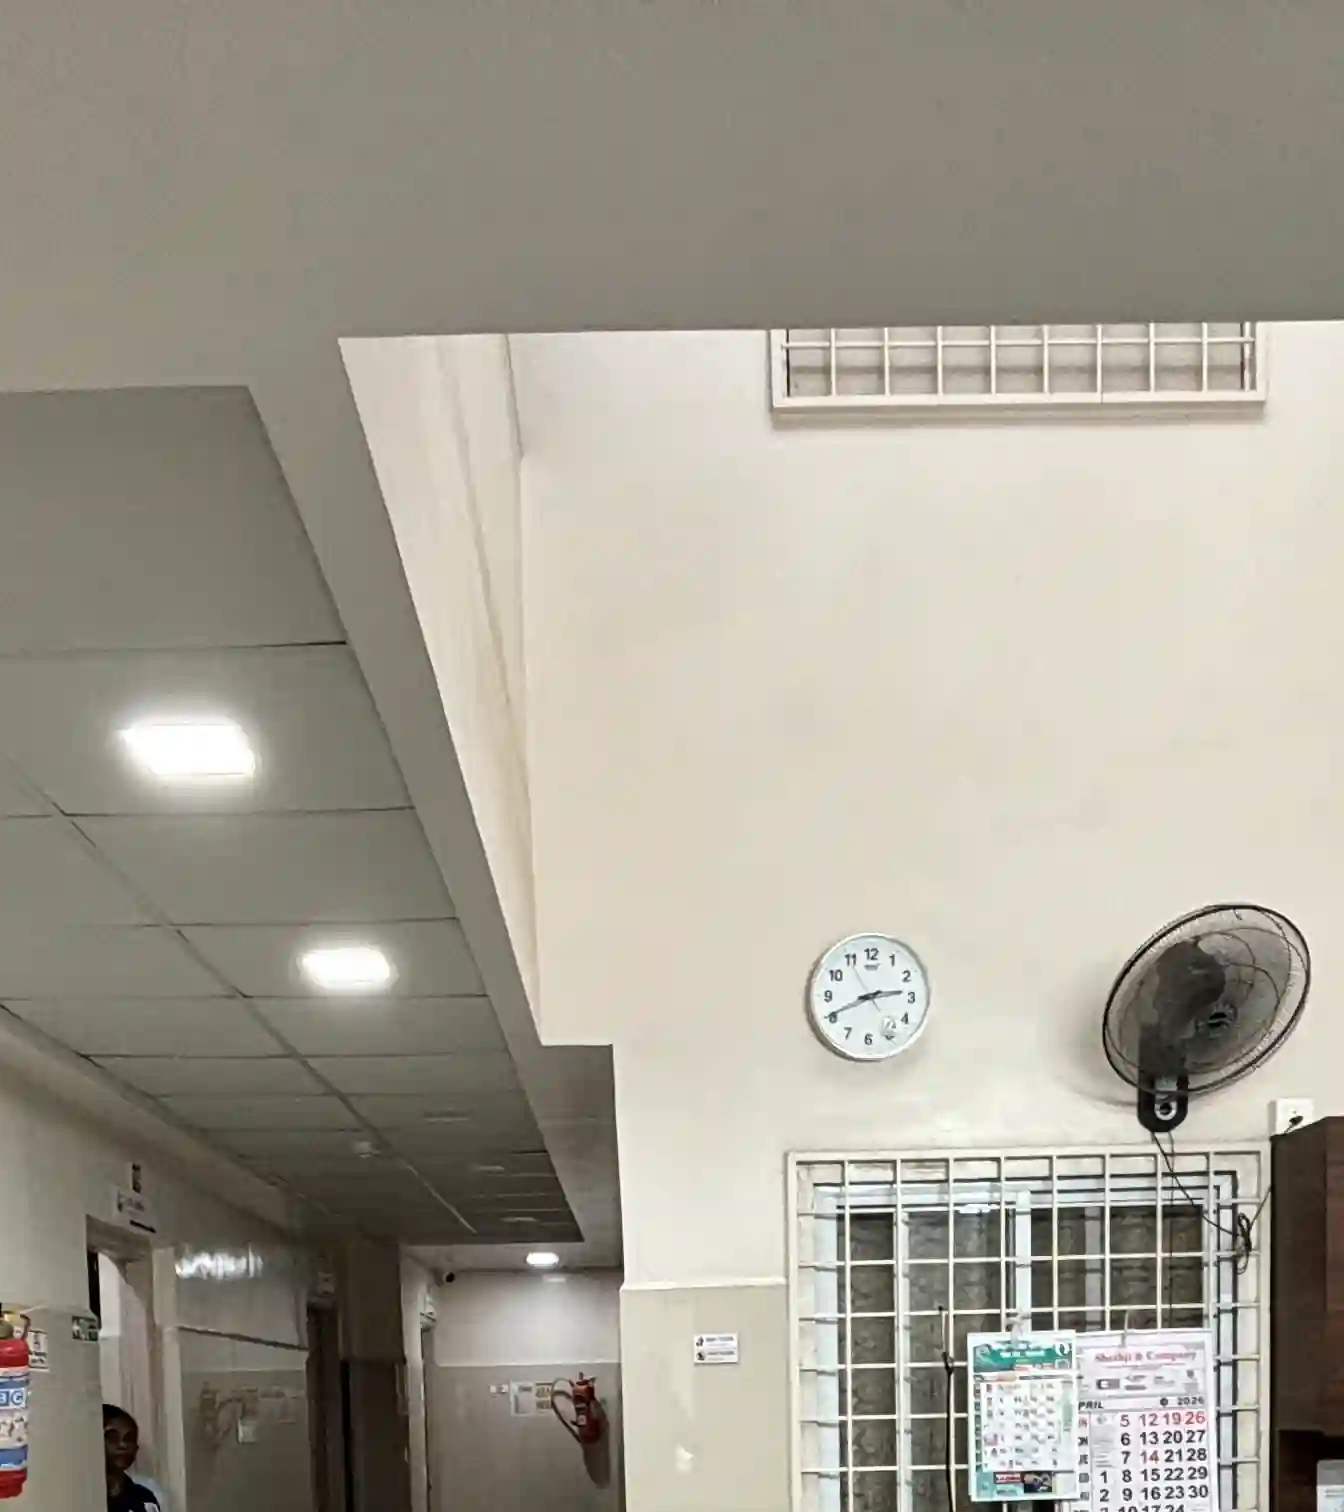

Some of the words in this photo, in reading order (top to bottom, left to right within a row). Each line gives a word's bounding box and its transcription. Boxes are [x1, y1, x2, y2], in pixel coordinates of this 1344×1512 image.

[845, 954, 857, 966] 11
[864, 948, 879, 961] 12
[890, 954, 896, 966] 1
[829, 969, 843, 981] 10
[902, 970, 911, 982] 2
[824, 990, 833, 1003] 9
[907, 992, 915, 1004] 3
[901, 1013, 909, 1024] 4
[844, 1027, 852, 1039] 7
[864, 1033, 872, 1045] 6
[1078, 1401, 1104, 1410] PRIL
[1119, 1414, 1130, 1427] 5
[1139, 1413, 1159, 1426] 12
[1163, 1412, 1181, 1425] 19
[1185, 1411, 1205, 1425] 26
[1120, 1432, 1130, 1446] 6
[1140, 1432, 1159, 1445] 13
[1163, 1430, 1183, 1444] 20
[1186, 1430, 1205, 1443] 27
[1121, 1451, 1131, 1464] 7
[1140, 1450, 1160, 1464] 14
[1164, 1449, 1183, 1463] 21
[1186, 1448, 1207, 1461] 28
[1100, 1471, 1108, 1484] 1
[1122, 1469, 1132, 1483] 8
[1140, 1469, 1160, 1482] 15
[1164, 1468, 1184, 1481] 22
[1187, 1467, 1208, 1480] 29
[1100, 1489, 1109, 1502] 2
[1122, 1488, 1133, 1501] 9
[1141, 1487, 1161, 1500] 16
[1164, 1486, 1185, 1499] 23
[1188, 1485, 1209, 1499] 30
